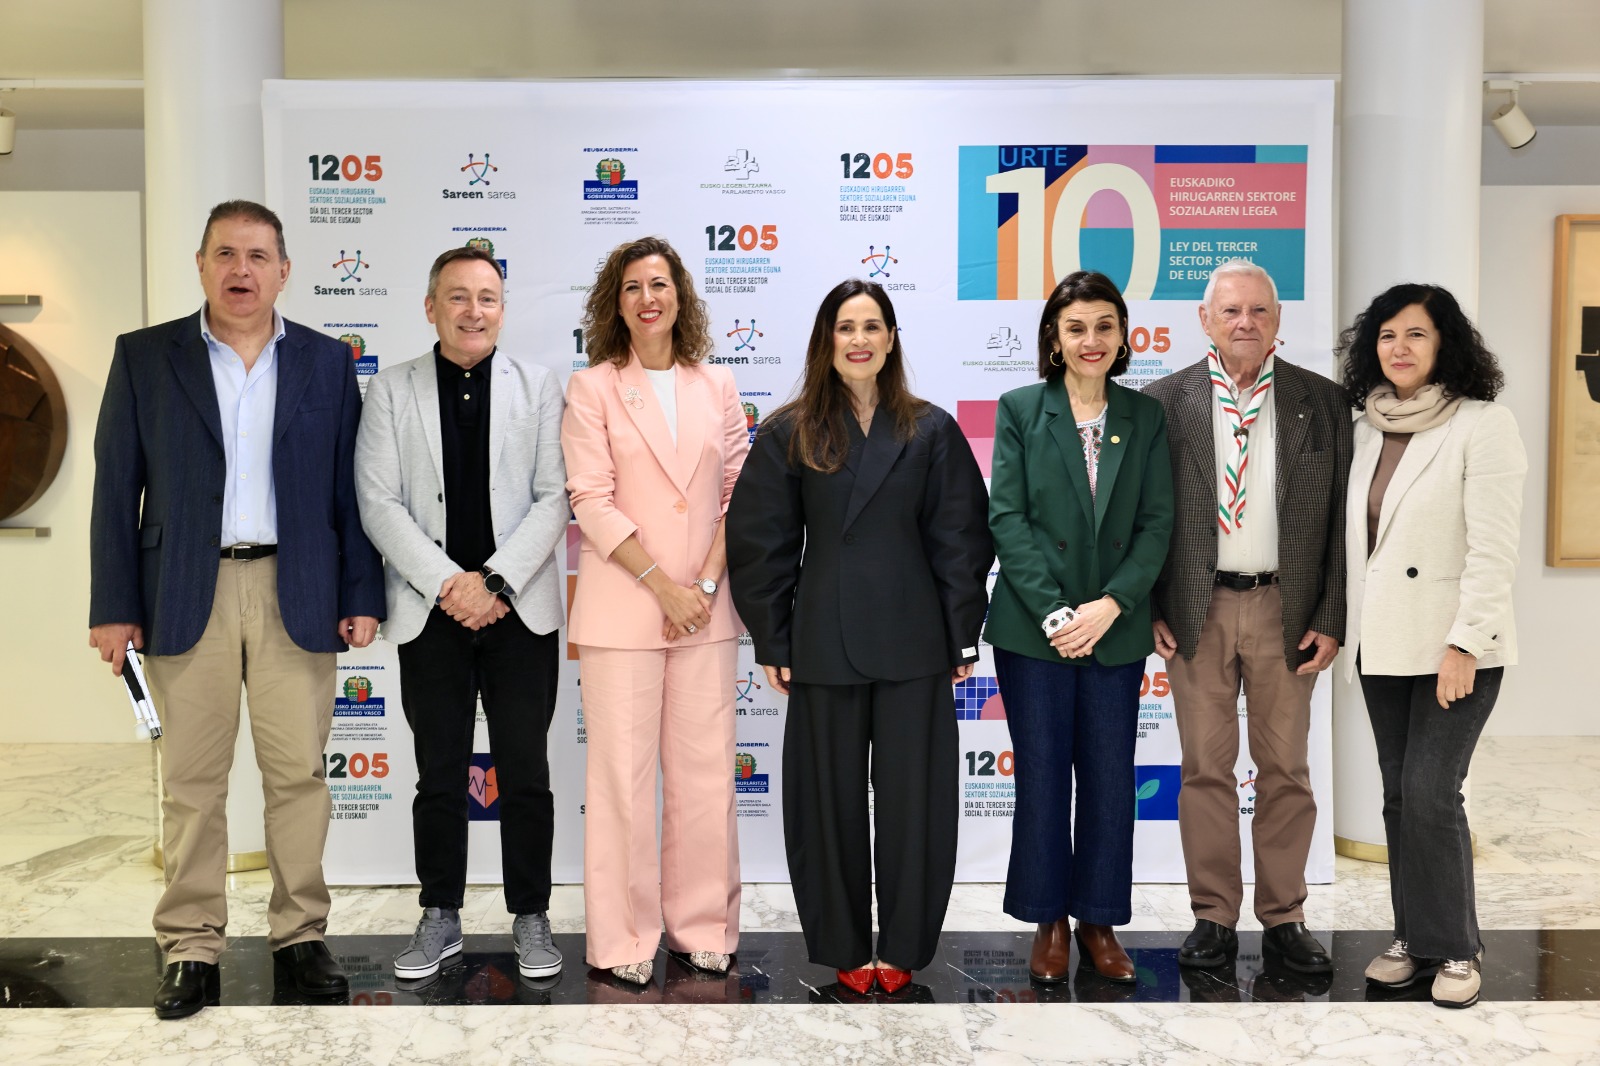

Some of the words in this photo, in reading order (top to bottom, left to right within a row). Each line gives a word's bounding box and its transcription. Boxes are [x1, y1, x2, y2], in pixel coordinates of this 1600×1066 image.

[1001, 148, 1068, 167] URTE
[308, 154, 383, 182] 1205
[840, 153, 914, 179] 1205
[1170, 177, 1235, 188] EUSKADIKO
[309, 188, 339, 196] EUSKADIKO
[340, 187, 375, 195] HIRUGARREN
[442, 189, 484, 199] Sareen
[487, 191, 516, 199] sarea
[309, 196, 333, 204] SEKTORE
[334, 196, 367, 204] SOZIALAREN
[368, 196, 386, 204] EGUNA
[840, 194, 863, 202] SEKTORE
[864, 194, 897, 202] SOZIALAREN
[898, 194, 916, 202] EGUNA
[1170, 192, 1244, 202] HIRUGARREN
[1247, 192, 1296, 202] SEKTORE
[310, 206, 319, 215] DÍA
[320, 207, 330, 215] DEL
[332, 207, 351, 215] TERCER
[352, 207, 373, 215] SECTOR
[840, 204, 849, 213] DÍA
[1169, 206, 1240, 216] SOZIALAREN
[1242, 206, 1278, 216] LEGEA
[310, 216, 329, 224] SOCIAL
[330, 216, 337, 224] DE
[338, 216, 361, 224] EUSKADI
[840, 214, 858, 222] SOCIAL
[860, 214, 867, 222] DE
[868, 214, 891, 222] EUSKADI
[986, 163, 1161, 300] 10
[705, 225, 779, 251] 1205
[1169, 242, 1189, 252] LEY
[1192, 242, 1214, 252] DEL
[1216, 242, 1258, 252] TERCER
[1169, 256, 1213, 266] SECTOR
[705, 266, 729, 274] SEKTORE
[730, 266, 762, 274] SOZIALAREN
[1169, 270, 1184, 280] DE
[705, 276, 714, 285] DÍA
[716, 277, 726, 285] DEL
[726, 277, 746, 285] TERCER
[748, 277, 768, 285] SECTOR
[314, 286, 355, 296] Sareen
[359, 287, 388, 296] sarea
[705, 286, 724, 294] SOCIAL
[725, 286, 732, 294] DE
[887, 283, 916, 291] sarea
[1129, 327, 1171, 353] 05
[708, 355, 749, 365] Sareen
[753, 356, 781, 365] sarea
[750, 708, 779, 716] sarea
[966, 751, 1014, 776] 120
